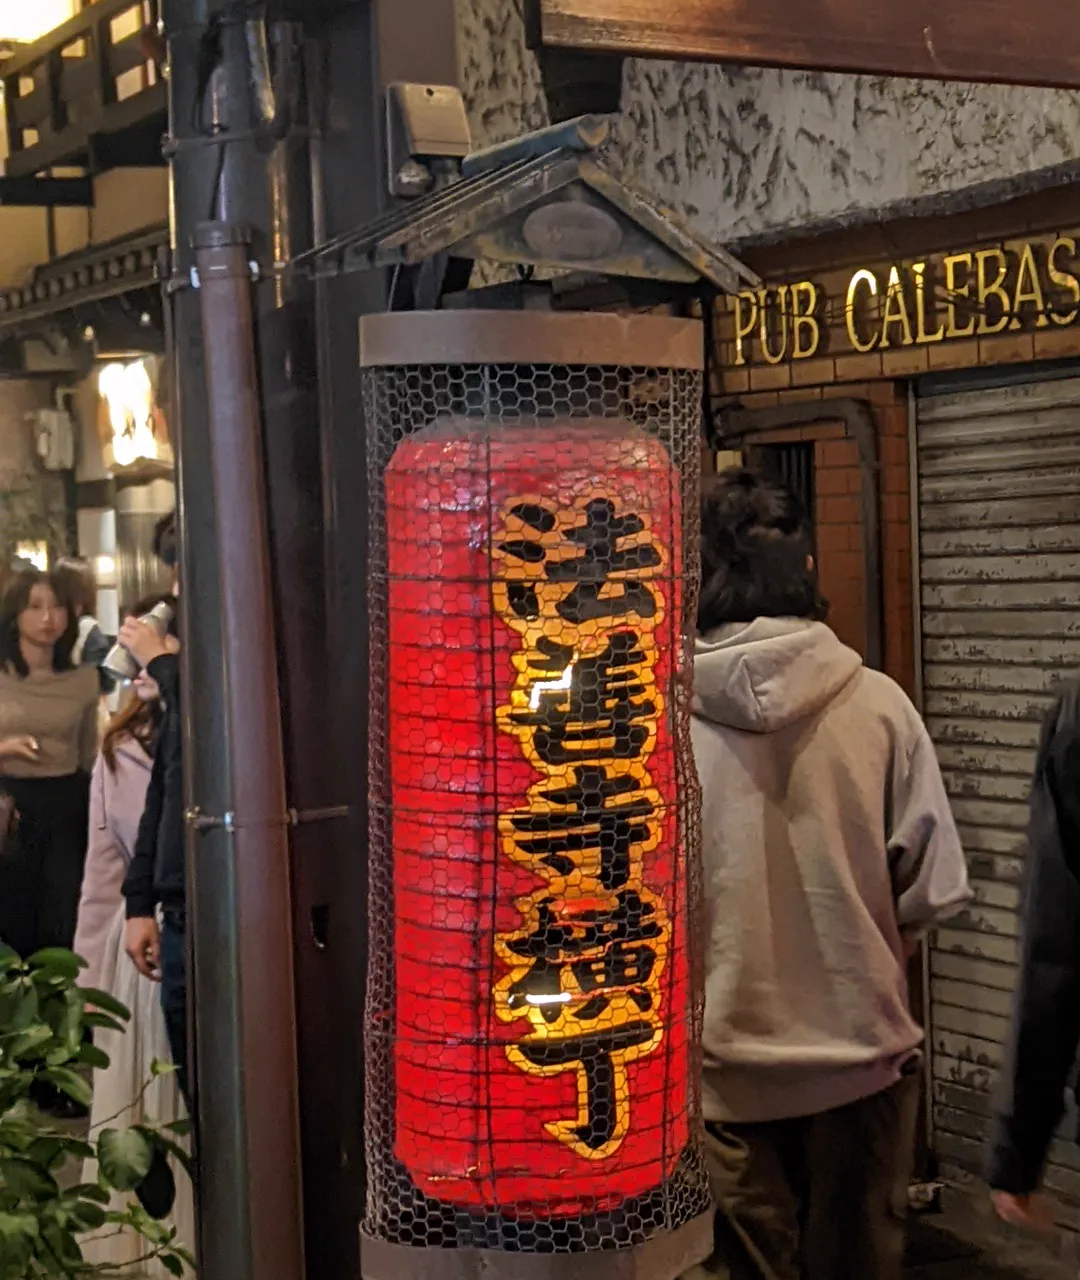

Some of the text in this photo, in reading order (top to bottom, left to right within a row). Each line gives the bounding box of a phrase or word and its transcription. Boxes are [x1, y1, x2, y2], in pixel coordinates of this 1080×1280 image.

[734, 280, 819, 366] PUB
[496, 496, 664, 1156] 法善寺横丁
